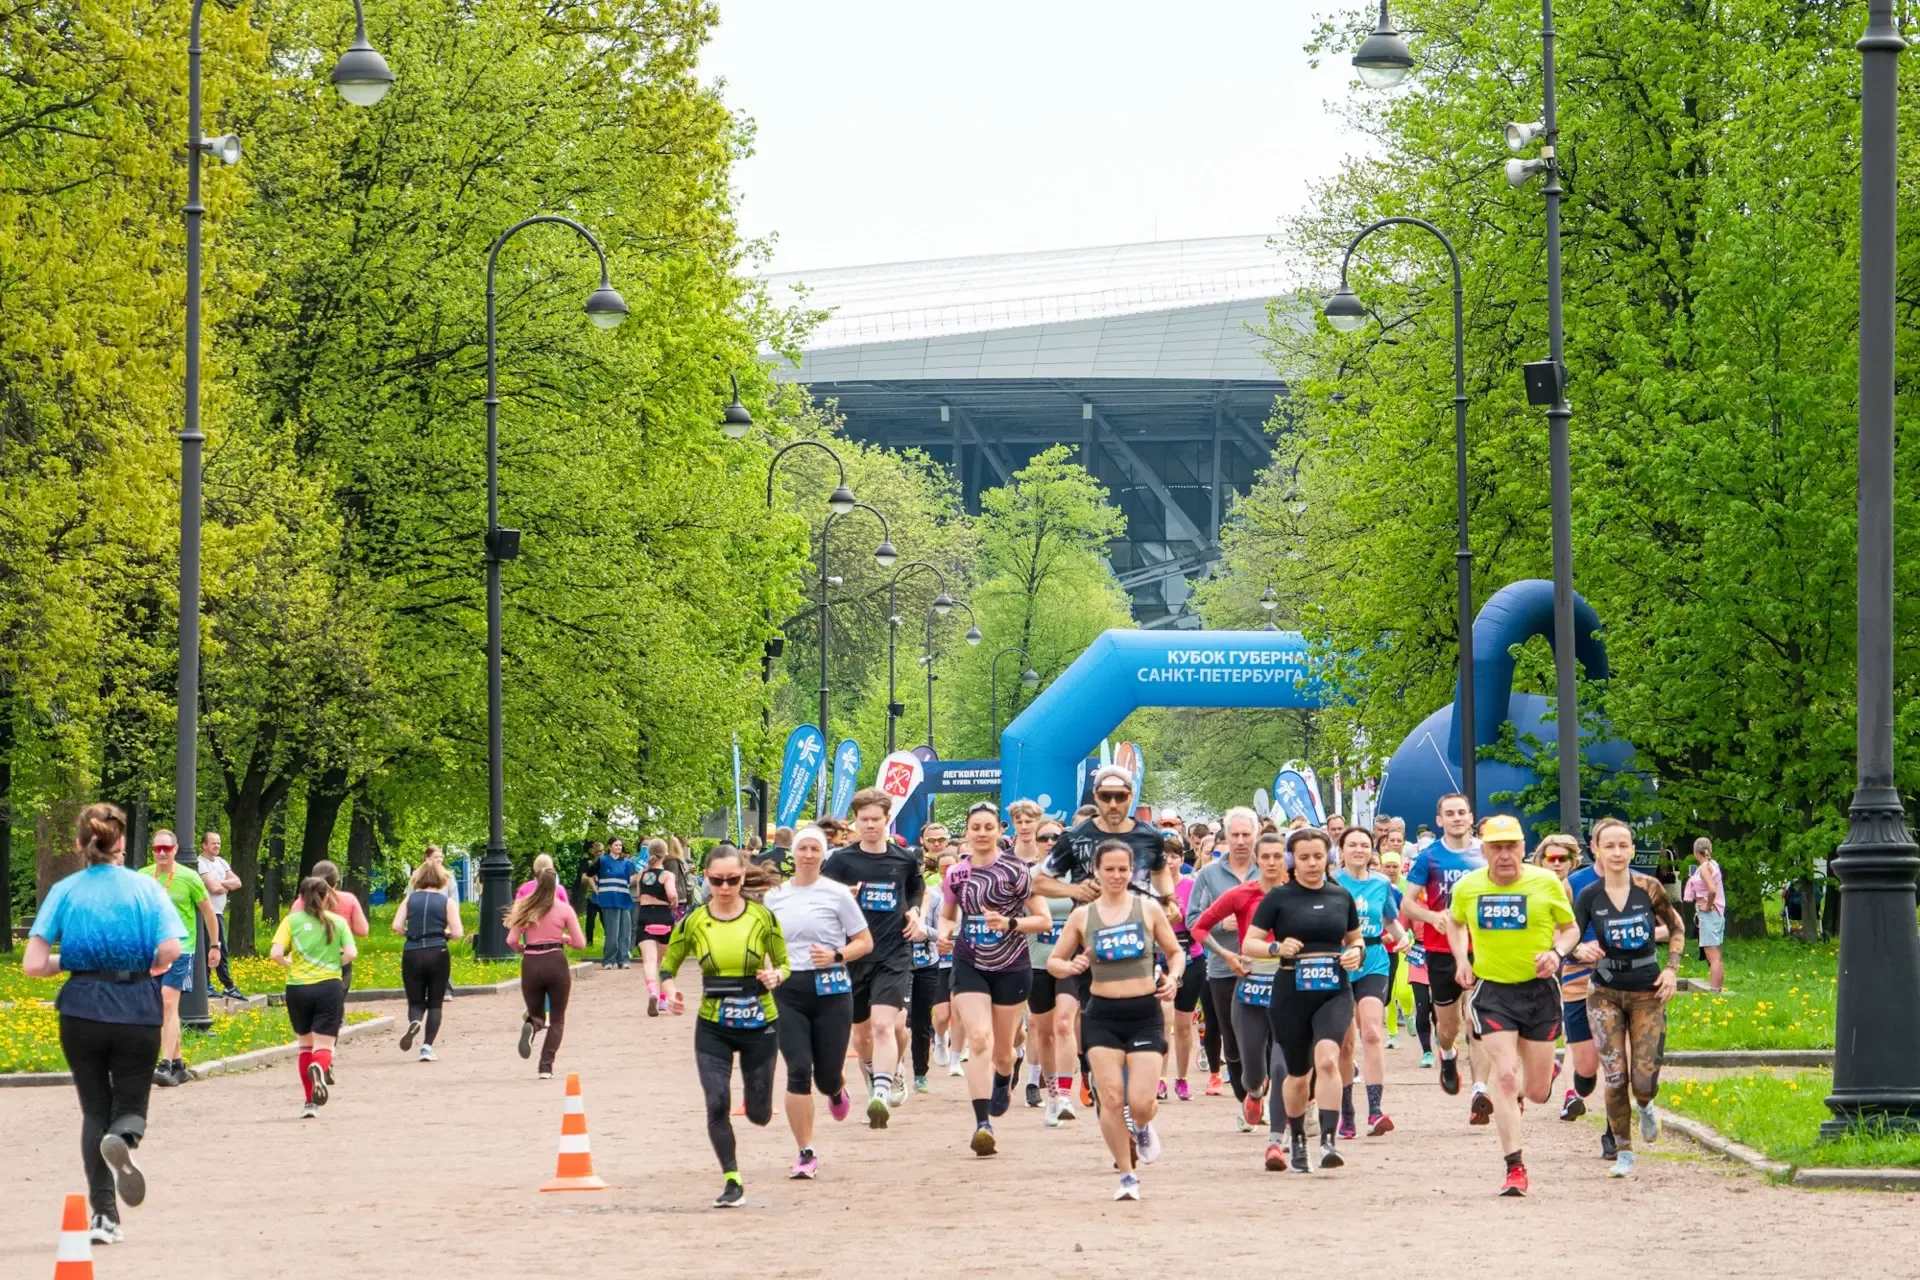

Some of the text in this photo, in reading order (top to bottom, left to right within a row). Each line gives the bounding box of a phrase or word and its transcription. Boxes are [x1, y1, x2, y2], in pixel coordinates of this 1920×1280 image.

[1168, 650, 1225, 665] КУБОК
[1137, 667, 1304, 683] САНКТ-ПЕТЕРБУРГА
[867, 891, 893, 901] 2269
[1483, 905, 1519, 918] 2593
[1611, 926, 1645, 940] 2118
[1102, 932, 1138, 950] 2149
[1302, 967, 1334, 979] 2025
[1243, 982, 1273, 996] 2077
[725, 1005, 759, 1019] 2207
